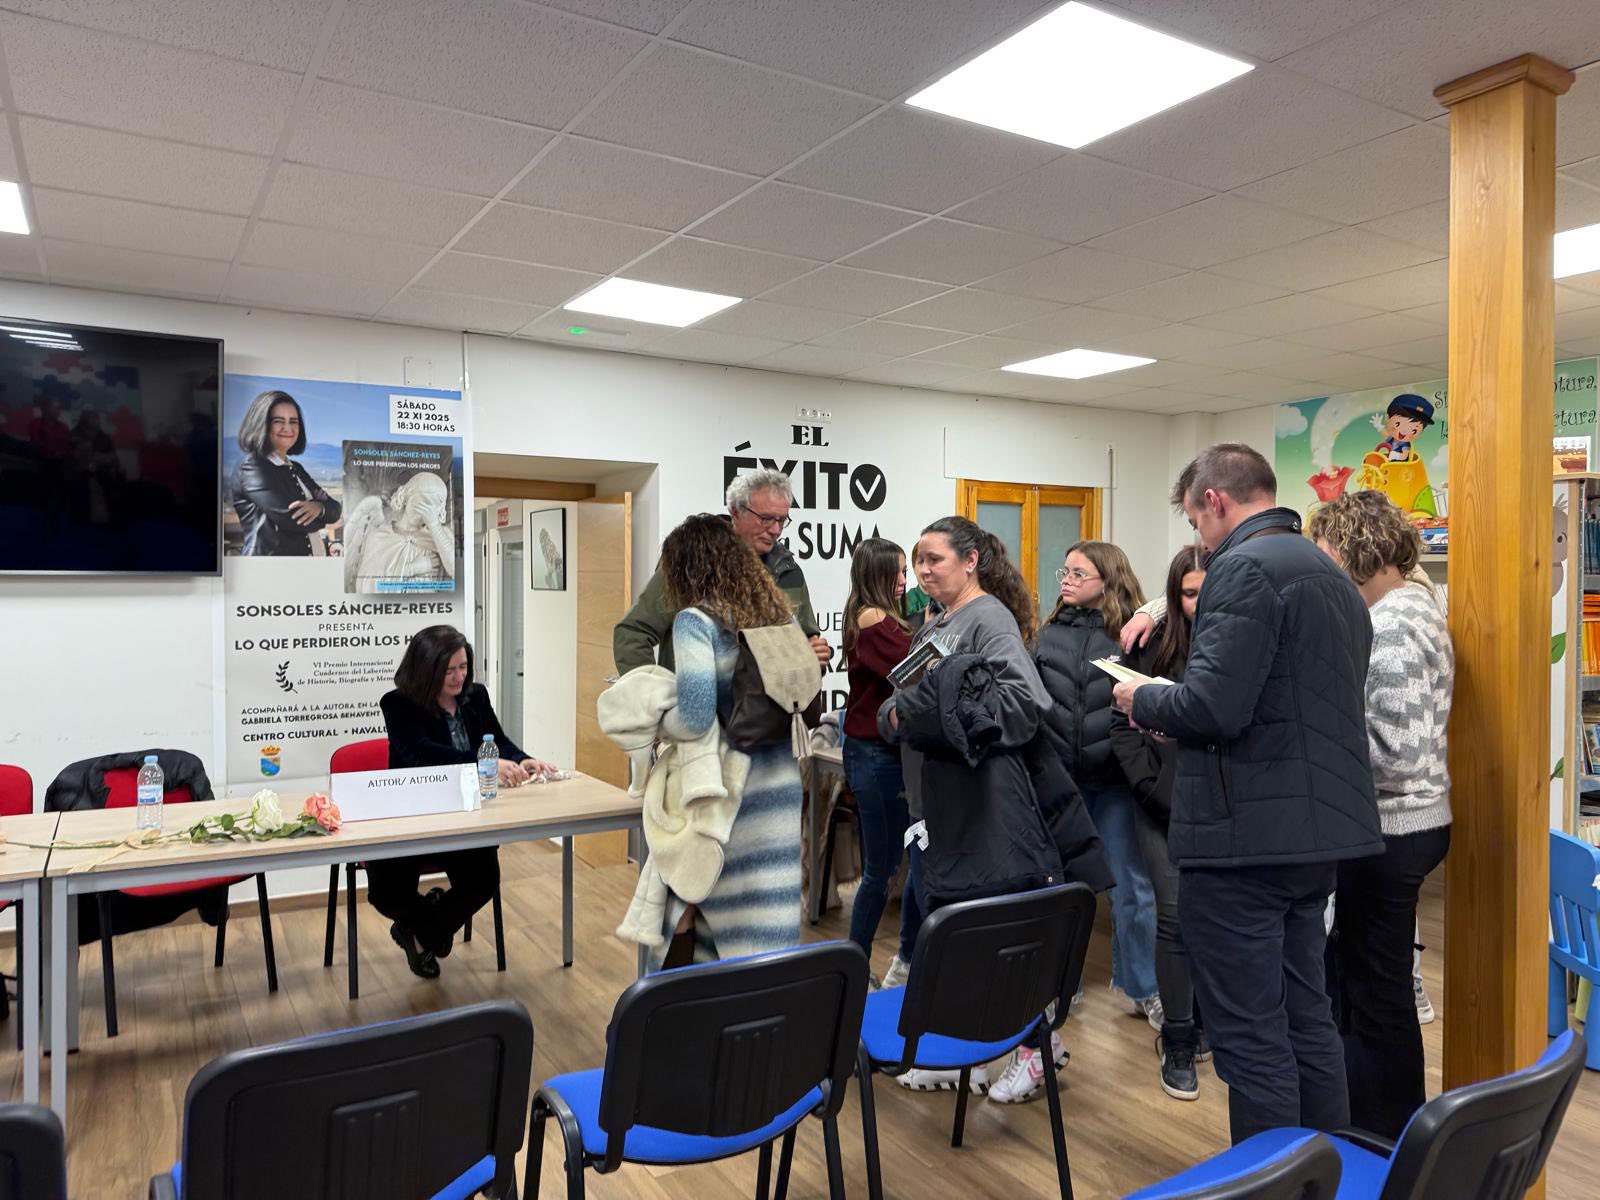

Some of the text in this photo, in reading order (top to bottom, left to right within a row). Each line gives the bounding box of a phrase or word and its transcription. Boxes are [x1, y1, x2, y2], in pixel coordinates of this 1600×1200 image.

[397, 399, 436, 411] SÁBADO
[397, 411, 450, 422] 22 XI 2025
[397, 421, 456, 432] 18:30 HORAS
[791, 425, 829, 447] EL
[353, 449, 441, 459] SONSOLES SÁNCHEZ-REYES
[236, 600, 453, 617] SONSOLES SÁNCHEZ-REYES
[318, 623, 374, 632] PRESENTA
[235, 640, 255, 651] LO
[259, 638, 289, 651] QUE
[292, 636, 371, 649] PERDIERON
[374, 635, 400, 647] LOS
[350, 659, 393, 667] Internacional
[307, 677, 337, 685] Historia,
[339, 676, 369, 684] Biografía
[241, 704, 299, 715] ACOMPAÑARÁ
[310, 703, 321, 711] LA
[323, 701, 355, 710] AUTORA
[357, 701, 368, 709] EN
[369, 700, 379, 708] LA
[241, 716, 282, 725] GABRIELA
[284, 712, 339, 723] TORREGROSA
[242, 732, 286, 742] CENTRO
[287, 728, 339, 740] CULTURAL
[368, 774, 448, 788] AUTOR/ AUTORA
